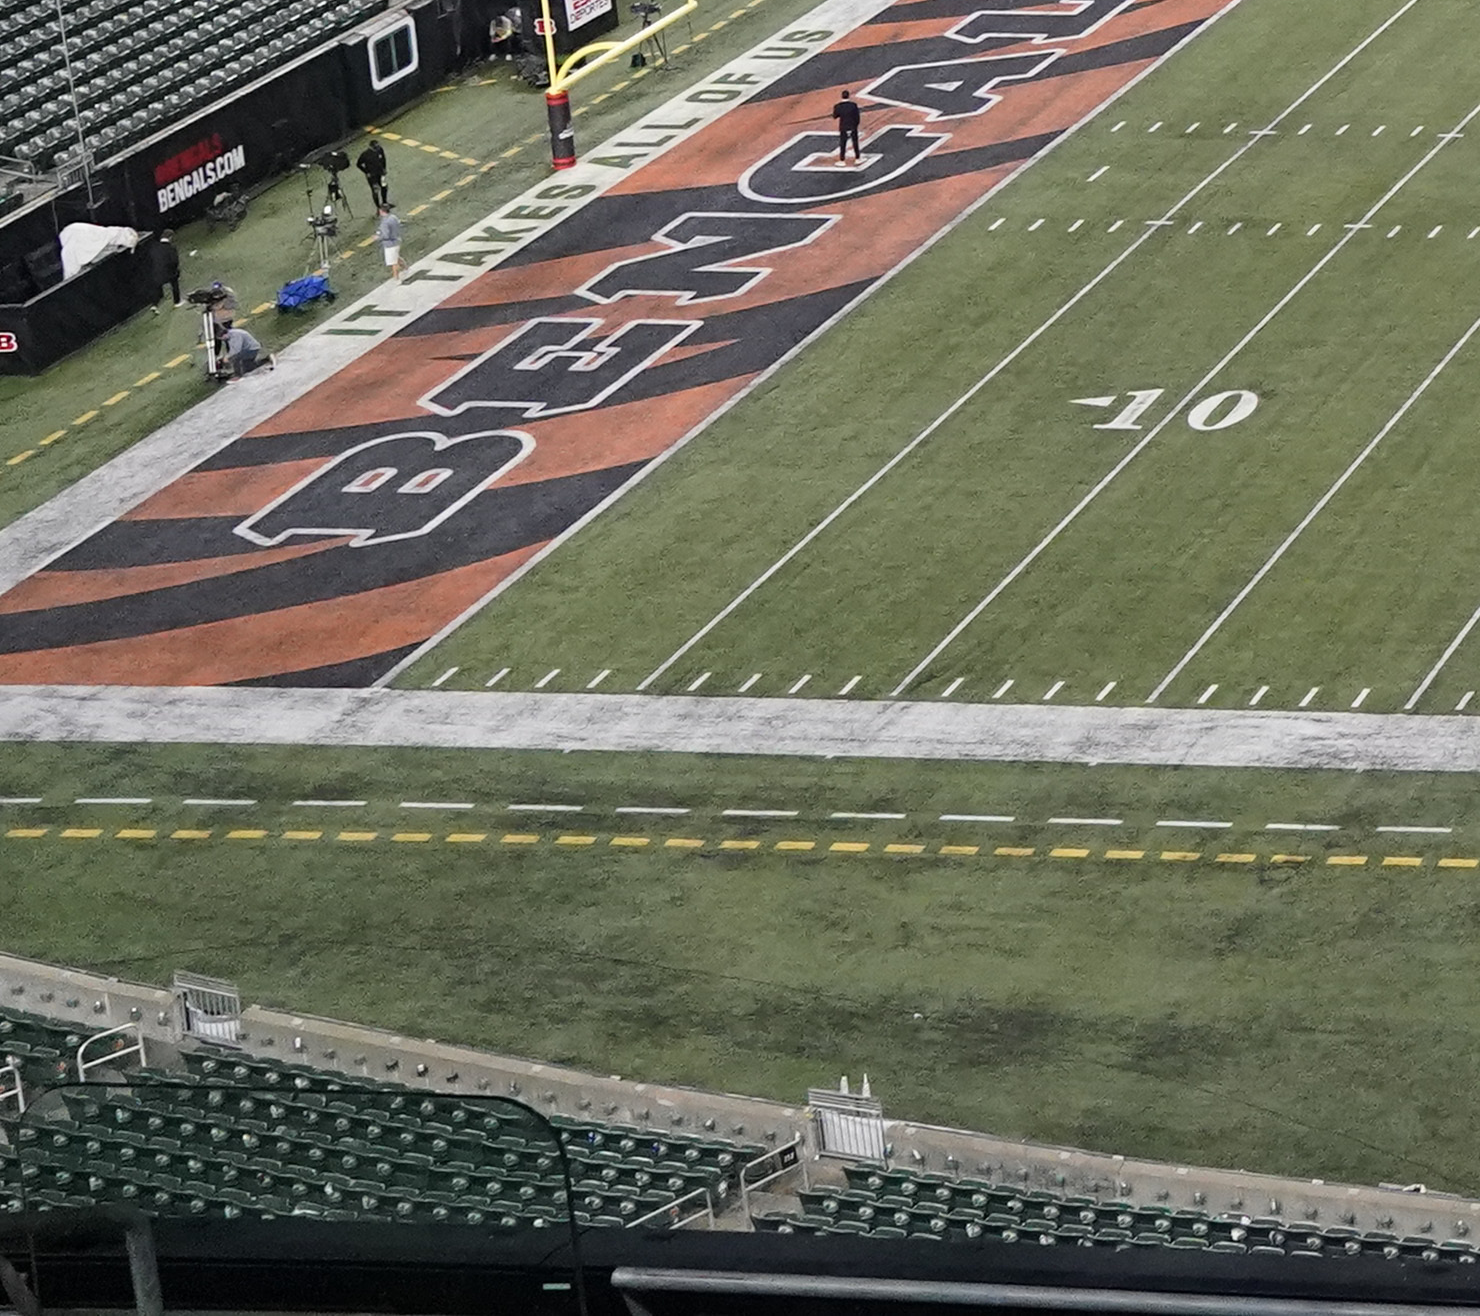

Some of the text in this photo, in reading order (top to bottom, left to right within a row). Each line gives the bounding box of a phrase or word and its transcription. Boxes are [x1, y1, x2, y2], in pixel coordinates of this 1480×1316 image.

[157, 144, 246, 214] BENGALS.COM
[326, 29, 834, 336] IT TAKES ALL OF US
